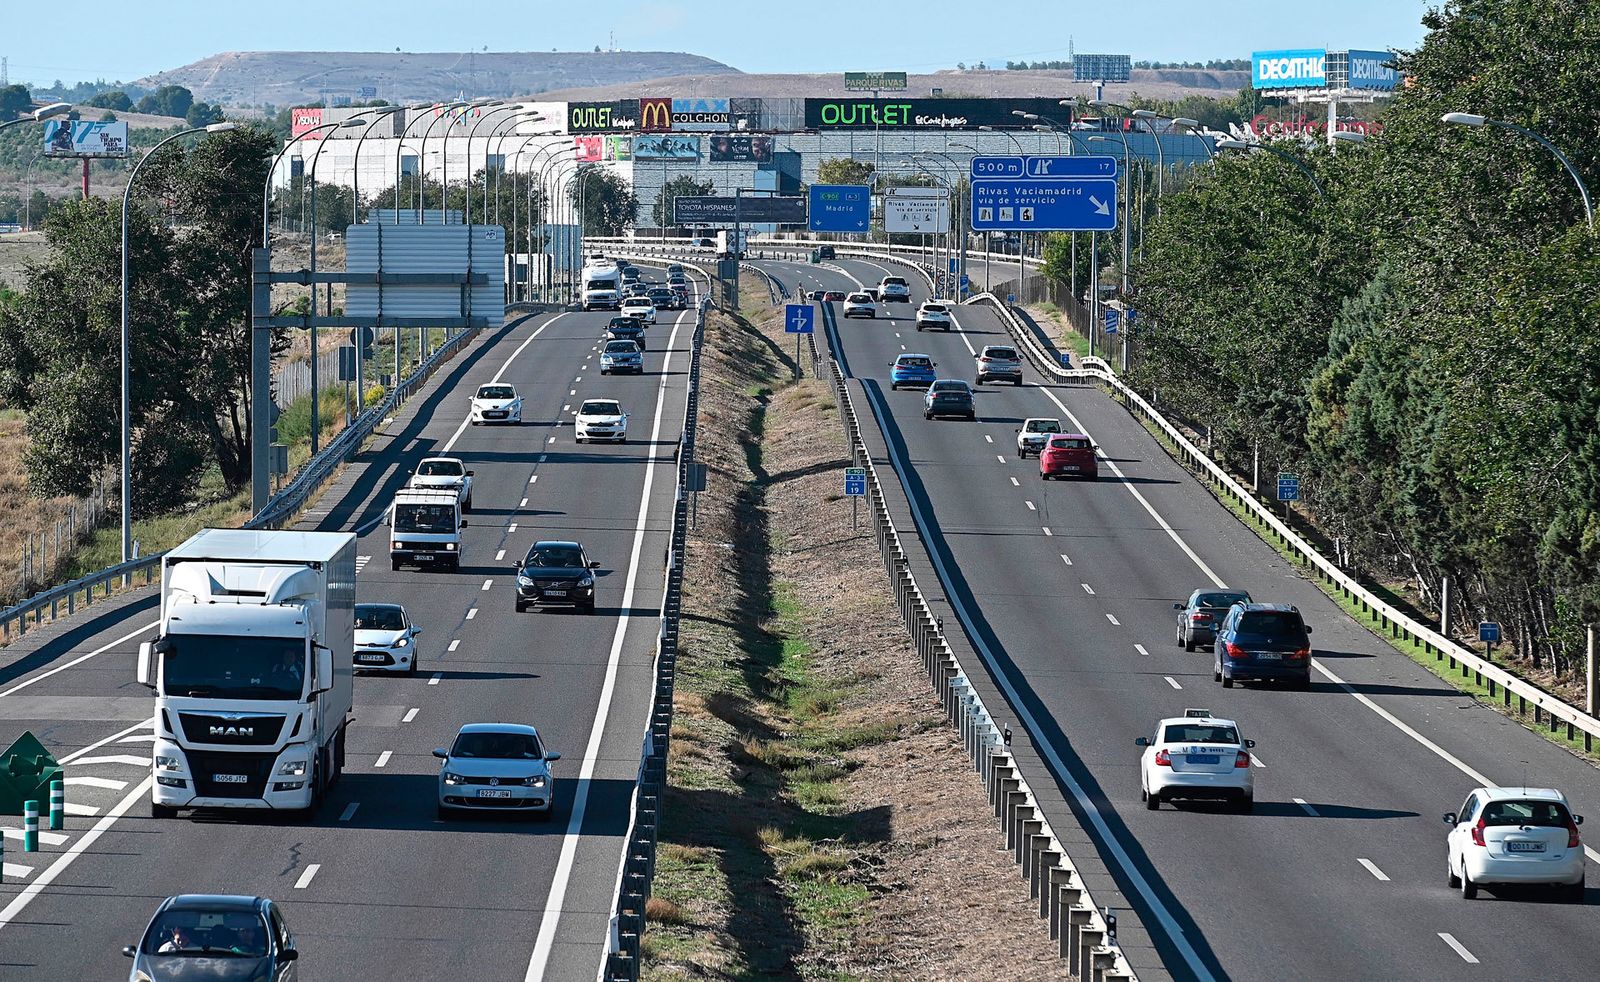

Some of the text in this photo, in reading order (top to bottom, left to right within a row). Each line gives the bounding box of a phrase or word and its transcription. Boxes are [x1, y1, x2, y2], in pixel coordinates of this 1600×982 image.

[1352, 58, 1393, 80] DECATHLON
[845, 79, 905, 87] PARQUE RIVAS
[674, 100, 727, 112] MAX
[572, 107, 612, 129] OUTLET
[672, 113, 728, 123] COLCHON
[821, 104, 912, 125] OUTLET
[978, 163, 1018, 172] 500 m
[978, 187, 1082, 195] Rivas Vaciamadrid
[209, 725, 254, 736] MAN
[216, 774, 233, 782] 5056
